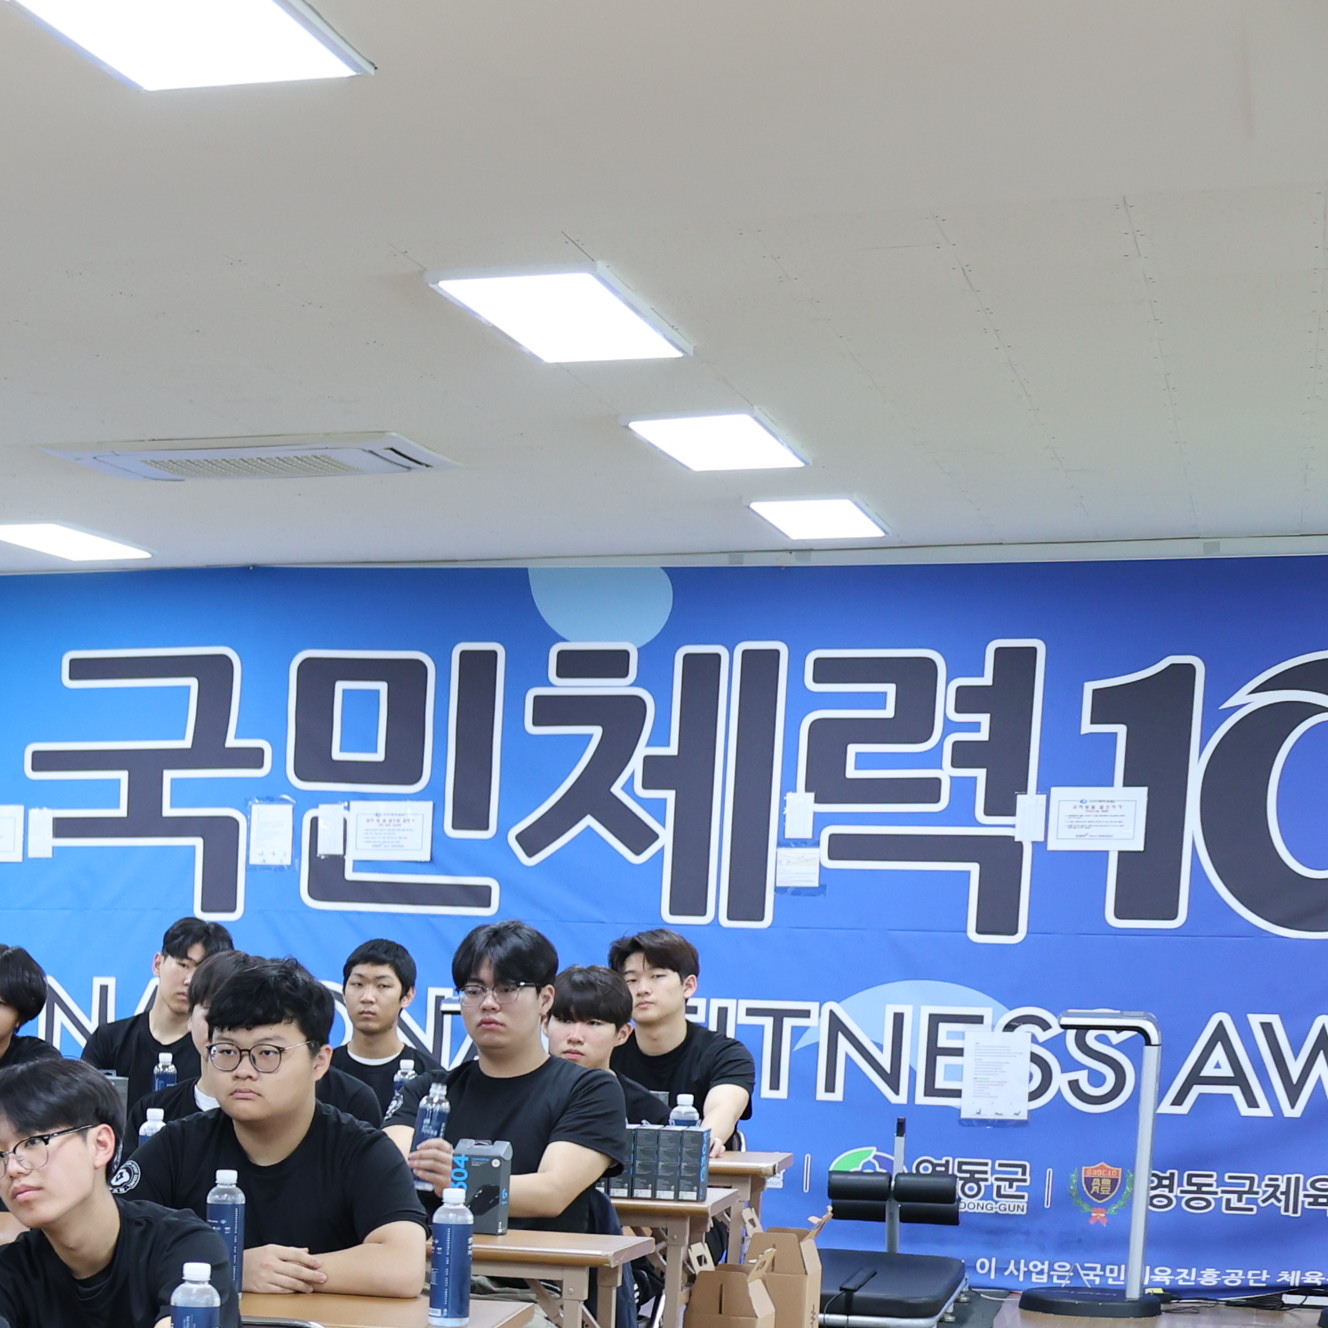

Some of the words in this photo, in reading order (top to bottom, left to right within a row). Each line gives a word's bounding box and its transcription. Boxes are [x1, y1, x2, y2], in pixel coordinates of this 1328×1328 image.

[686, 998, 1137, 1114] TNESS
[976, 1257, 998, 1281] 이
[1003, 1259, 1074, 1286] 사업은
[1081, 1263, 1271, 1287] 국민육진흥공단
[1276, 1269, 1328, 1288] 체육
